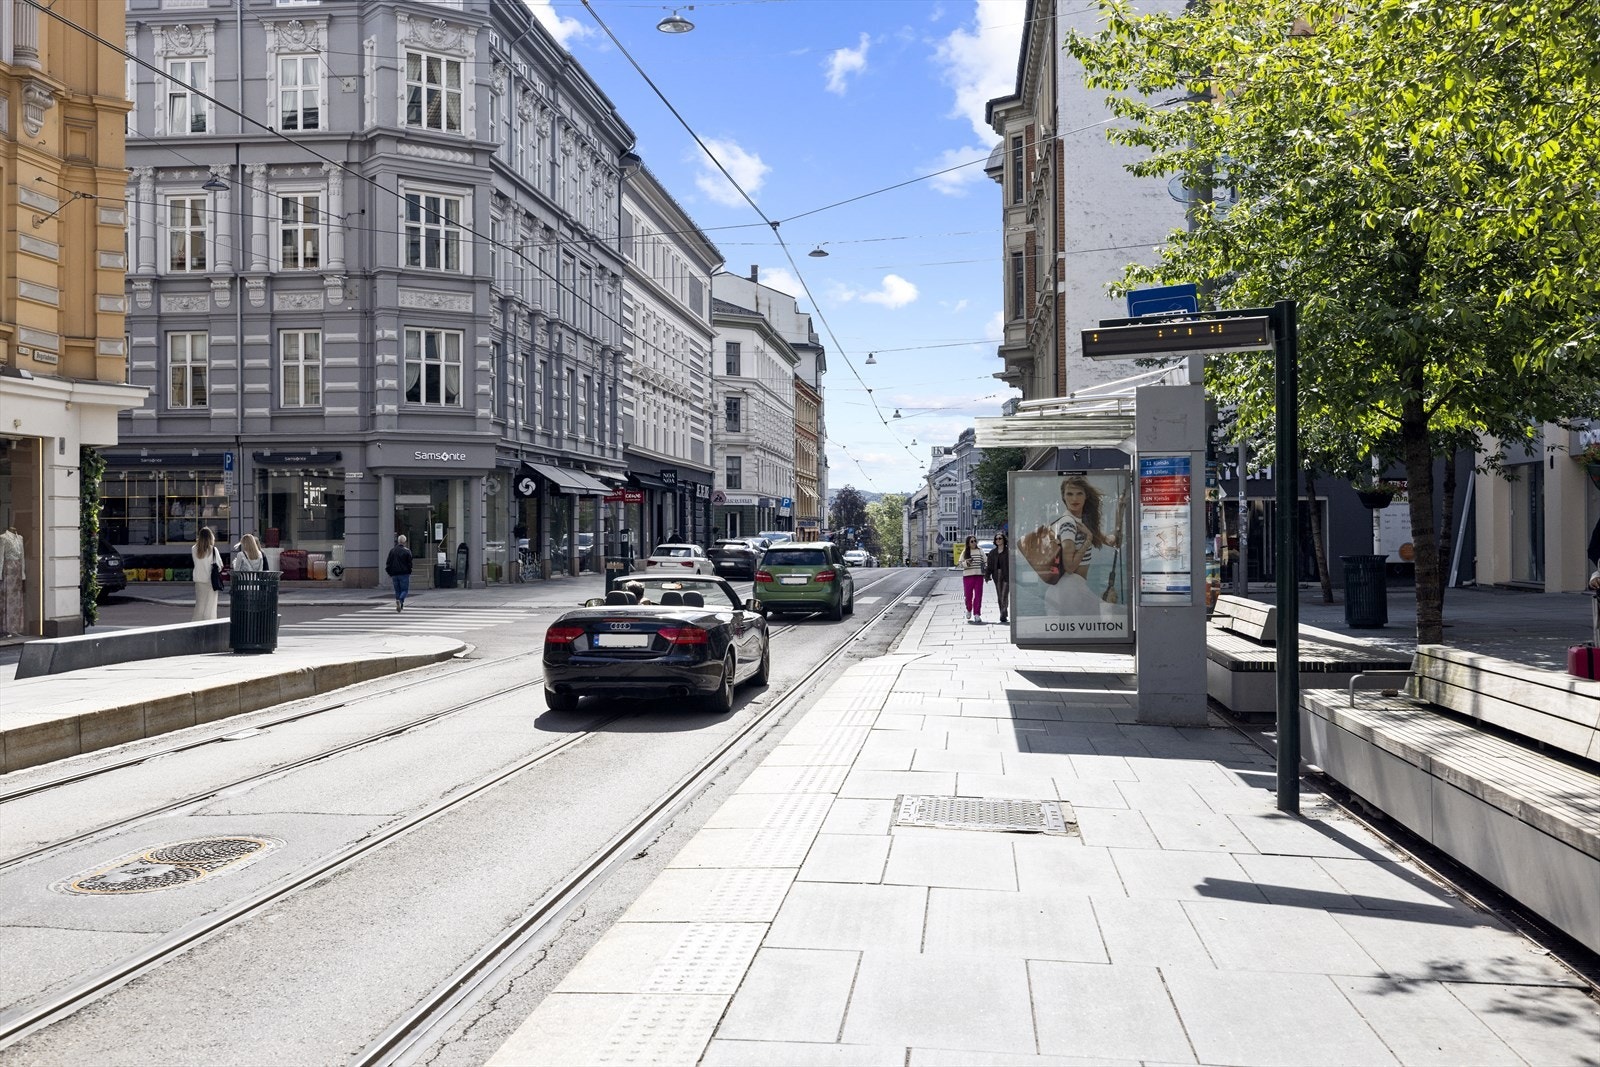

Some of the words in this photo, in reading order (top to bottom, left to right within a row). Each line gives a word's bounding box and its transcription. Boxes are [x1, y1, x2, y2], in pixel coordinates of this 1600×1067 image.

[225, 454, 231, 468] P
[414, 451, 466, 461] Samsonite
[783, 498, 789, 506] P
[974, 500, 980, 508] P
[1045, 623, 1076, 632] LOUIS
[1078, 622, 1123, 631] VUITTON
